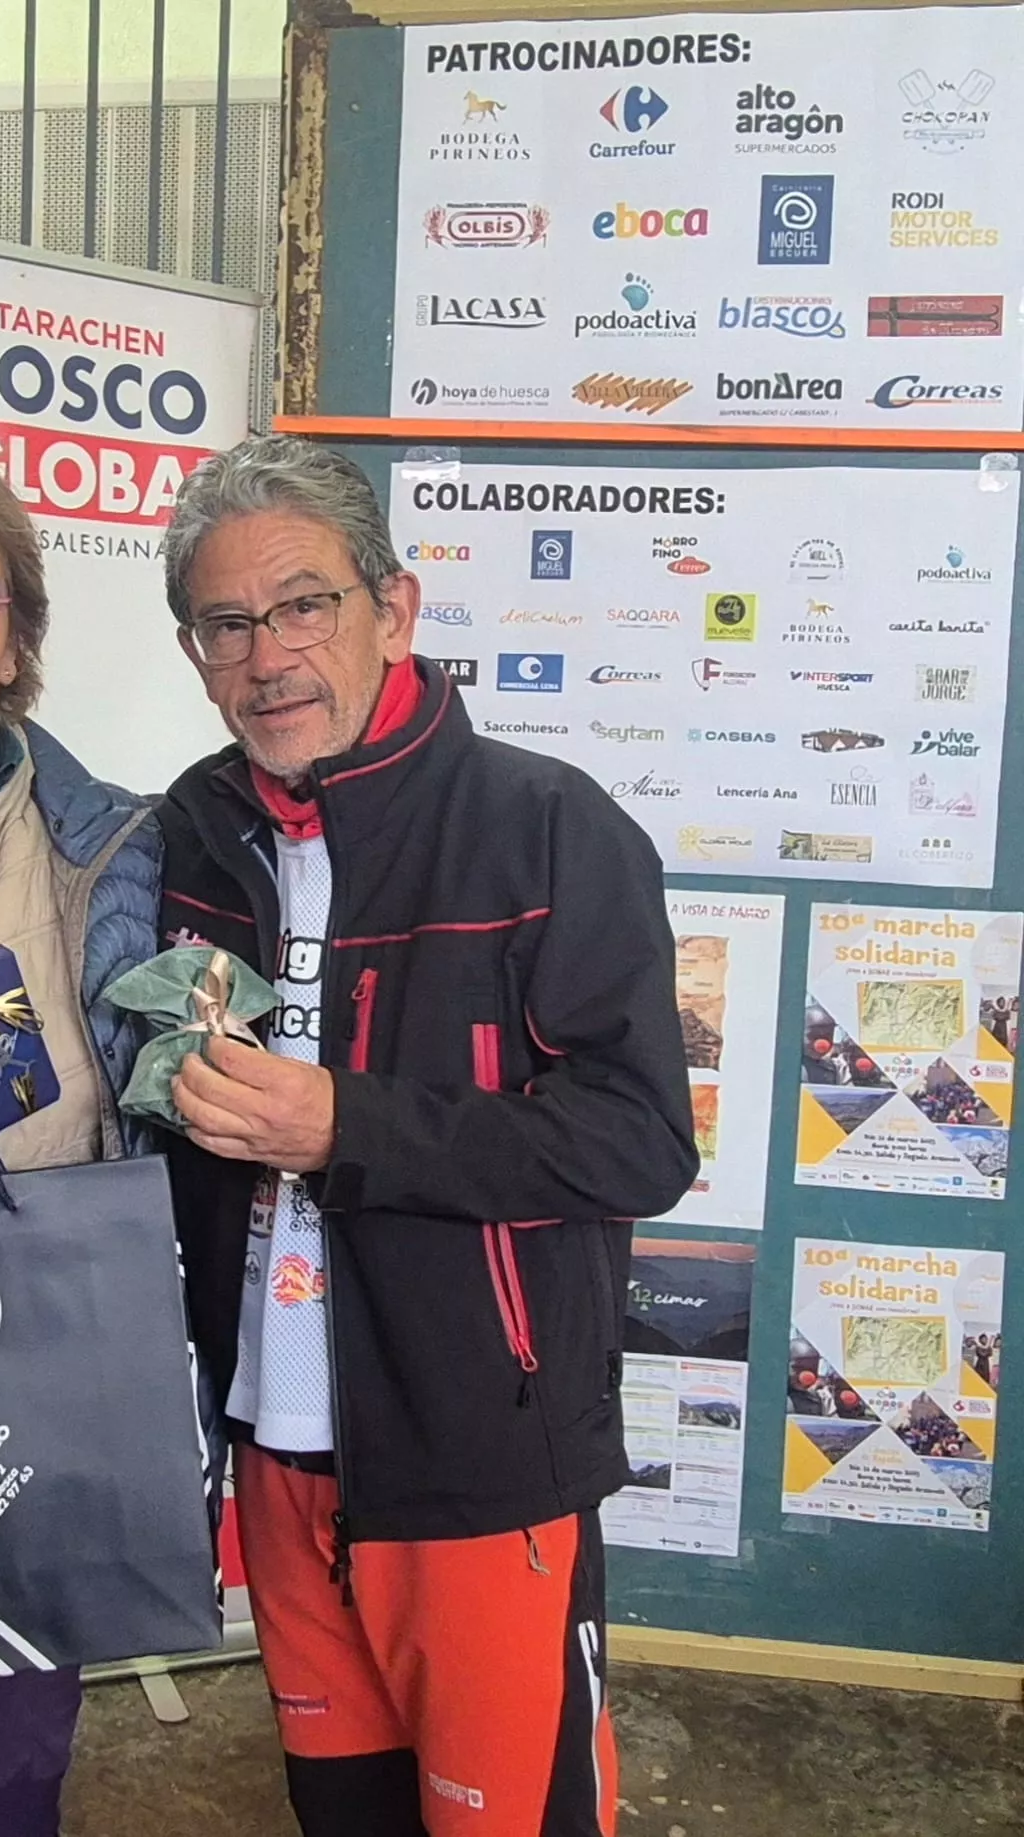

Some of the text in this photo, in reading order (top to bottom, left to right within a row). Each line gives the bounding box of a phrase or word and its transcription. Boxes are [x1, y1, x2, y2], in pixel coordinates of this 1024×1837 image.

[427, 33, 751, 73] PATROCINADORES:
[736, 83, 795, 110] alto
[441, 133, 520, 145] BODEGA
[430, 149, 531, 160] PIRINEOS
[589, 140, 676, 158] Carrefour
[735, 143, 837, 154] SUPERMERCADOS
[892, 192, 943, 209] RODI
[592, 202, 708, 239] eboca
[890, 211, 972, 228] MOTOR
[770, 231, 818, 249] MIGUEL
[889, 230, 998, 247] SERVICES
[430, 294, 546, 328] LACASA
[718, 297, 846, 338] blasco
[575, 309, 697, 338] podoactiva
[441, 385, 550, 401] hoya de huesca
[873, 375, 1003, 409] Correas
[413, 483, 725, 514] COLABORADORES:
[407, 541, 470, 561] eboca
[653, 549, 681, 558] FINO
[917, 567, 992, 582] podoactiva
[417, 604, 472, 626] asco
[607, 609, 680, 622] SAQQARA
[790, 624, 844, 633] BODEGA
[782, 634, 851, 643] PIRINEOS
[588, 665, 661, 684] Correas
[803, 673, 874, 682] INTERSPORT
[484, 721, 568, 734] Saccohuesca
[939, 728, 974, 743] vive
[705, 731, 776, 743] CASBAS
[773, 788, 798, 799] Ana
[831, 783, 876, 806] ESENCIA
[875, 914, 976, 939] marcha
[835, 940, 956, 968] solidaria
[856, 1251, 958, 1277] marcha
[819, 1275, 938, 1305] solidaria
